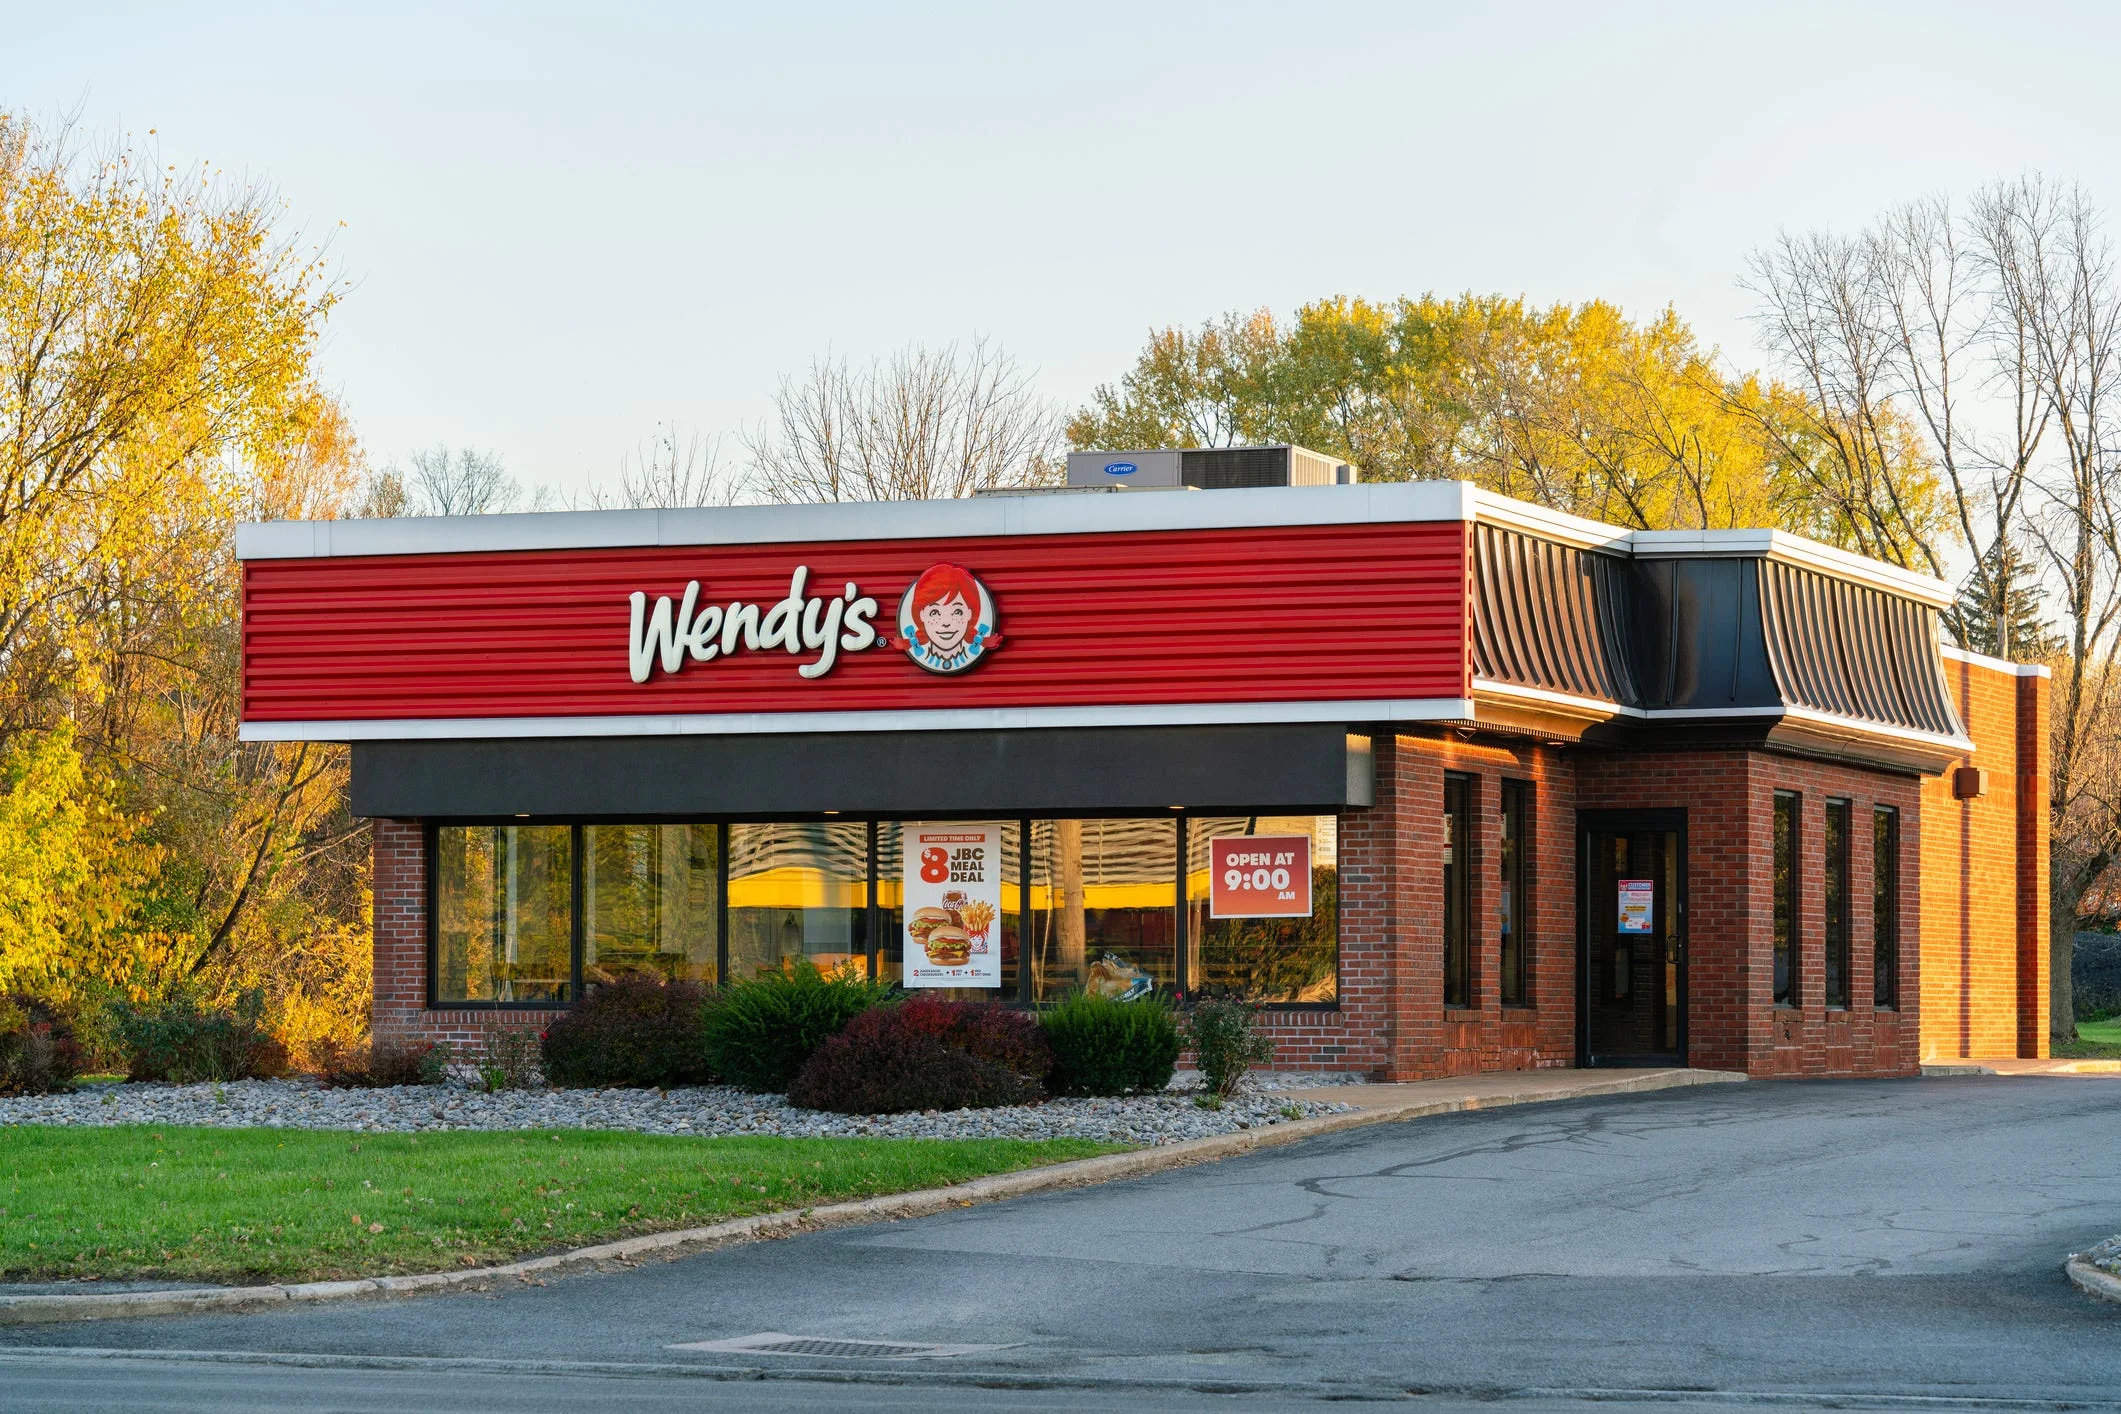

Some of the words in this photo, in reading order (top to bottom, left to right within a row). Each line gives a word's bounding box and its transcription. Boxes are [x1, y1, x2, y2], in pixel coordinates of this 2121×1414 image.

[1108, 465, 1134, 473] Carrier
[628, 565, 878, 684] Wendy's
[951, 847, 985, 861] JBC
[1226, 853, 1271, 867] OPEN
[1274, 852, 1295, 866] AT
[951, 861, 985, 871] MEAL
[951, 872, 985, 883] DEAL
[1224, 868, 1290, 891] 9:00
[1278, 892, 1295, 900] AM
[913, 969, 919, 977] 2
